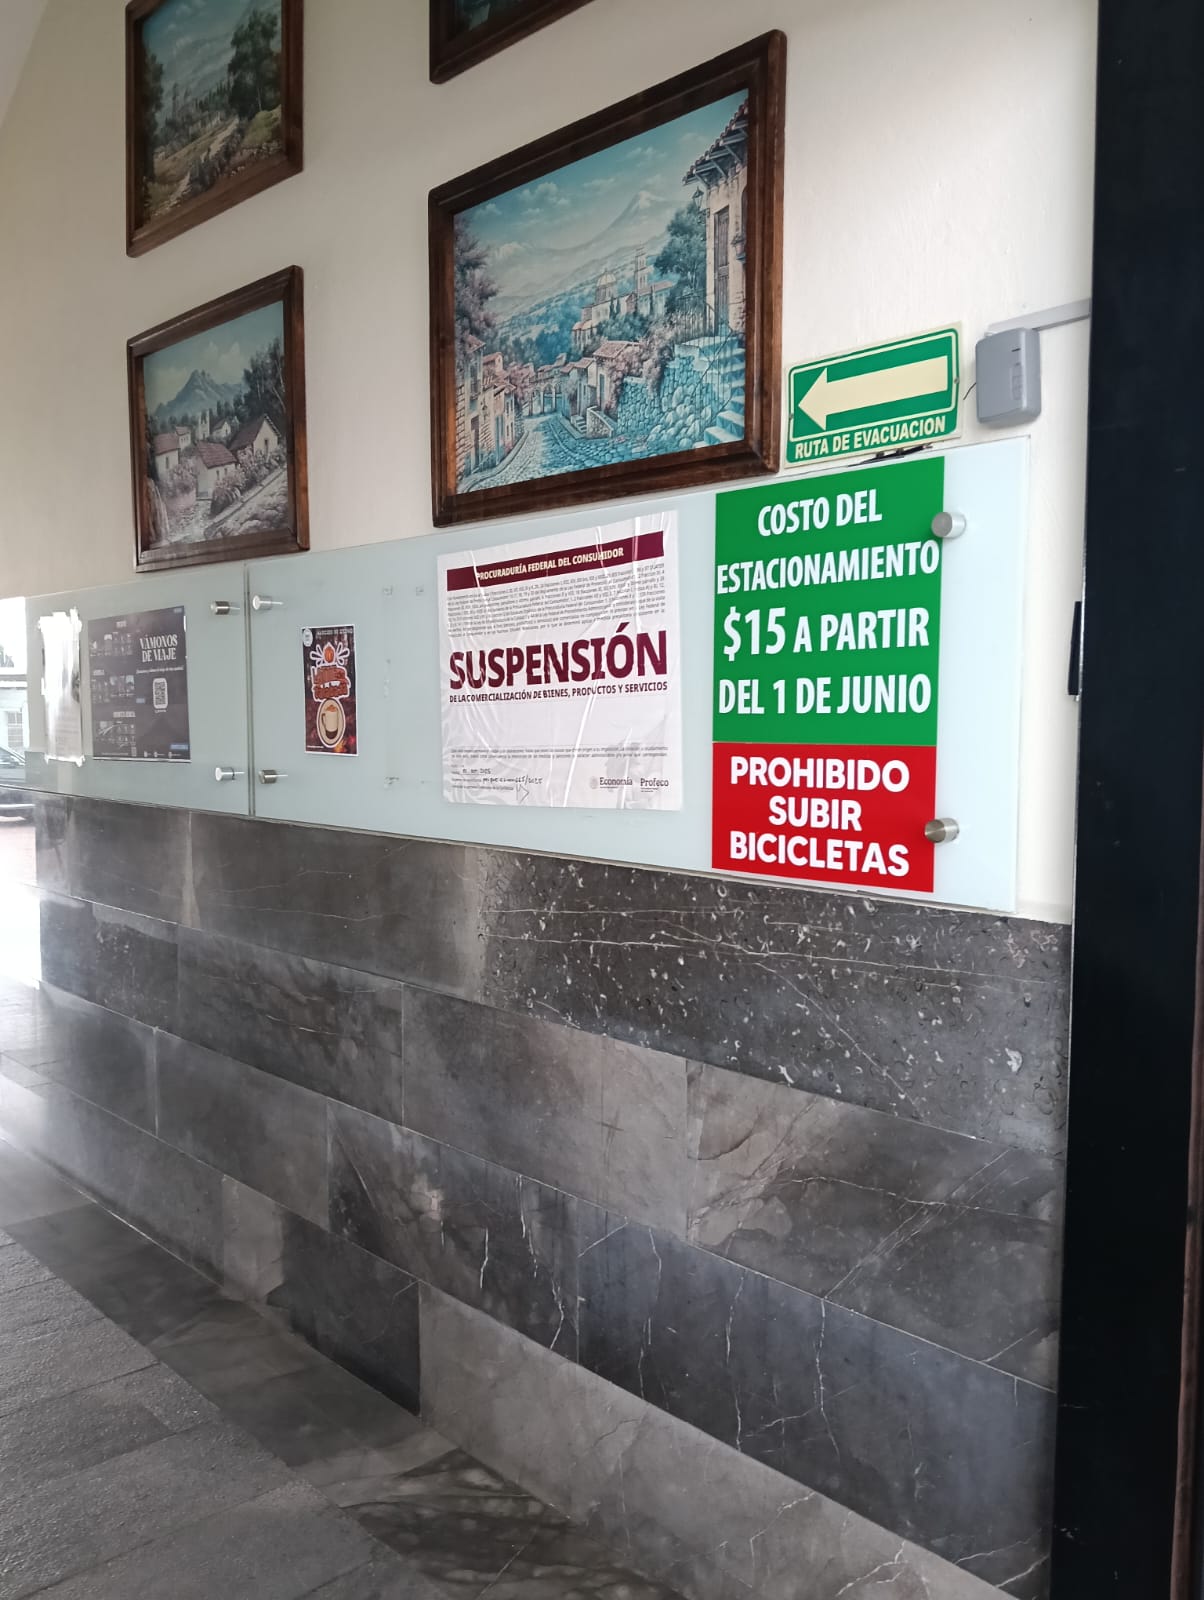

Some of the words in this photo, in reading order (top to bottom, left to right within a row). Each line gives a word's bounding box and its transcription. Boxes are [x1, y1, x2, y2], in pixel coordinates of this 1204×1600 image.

[794, 441, 829, 460] RUTA
[833, 434, 850, 453] DE
[853, 415, 946, 449] EVACUACION
[758, 496, 830, 537] COSTO
[836, 489, 883, 527] DEL
[476, 564, 527, 581] PROCURADURÍA
[527, 558, 557, 573] FEDERAL
[557, 555, 572, 569] DEL
[572, 547, 624, 565] CONSUMIDOR
[716, 539, 940, 594] ESTACIONAMIENTO
[139, 633, 178, 650] VÁMONOS
[723, 606, 786, 662] $15
[793, 616, 813, 653] A
[820, 607, 930, 652] PARTIR
[142, 649, 153, 662] DE
[153, 647, 177, 661] VIAJE
[449, 621, 668, 690] SUSPENSIÓN
[449, 694, 457, 703] DE
[532, 690, 542, 699] DE
[543, 688, 570, 699] BIENES,
[572, 685, 617, 697] PRODUCTOS
[618, 684, 624, 693] Y
[625, 681, 668, 693] SERVICIOS
[718, 679, 765, 714] DEL
[772, 679, 786, 714] 1
[796, 677, 831, 714] DE
[836, 673, 932, 714] JUNIO
[640, 777, 669, 787] Profeco
[730, 756, 910, 792] PROHIBIDO
[768, 795, 862, 831] SUBIR
[730, 830, 910, 877] BICICLETAS
